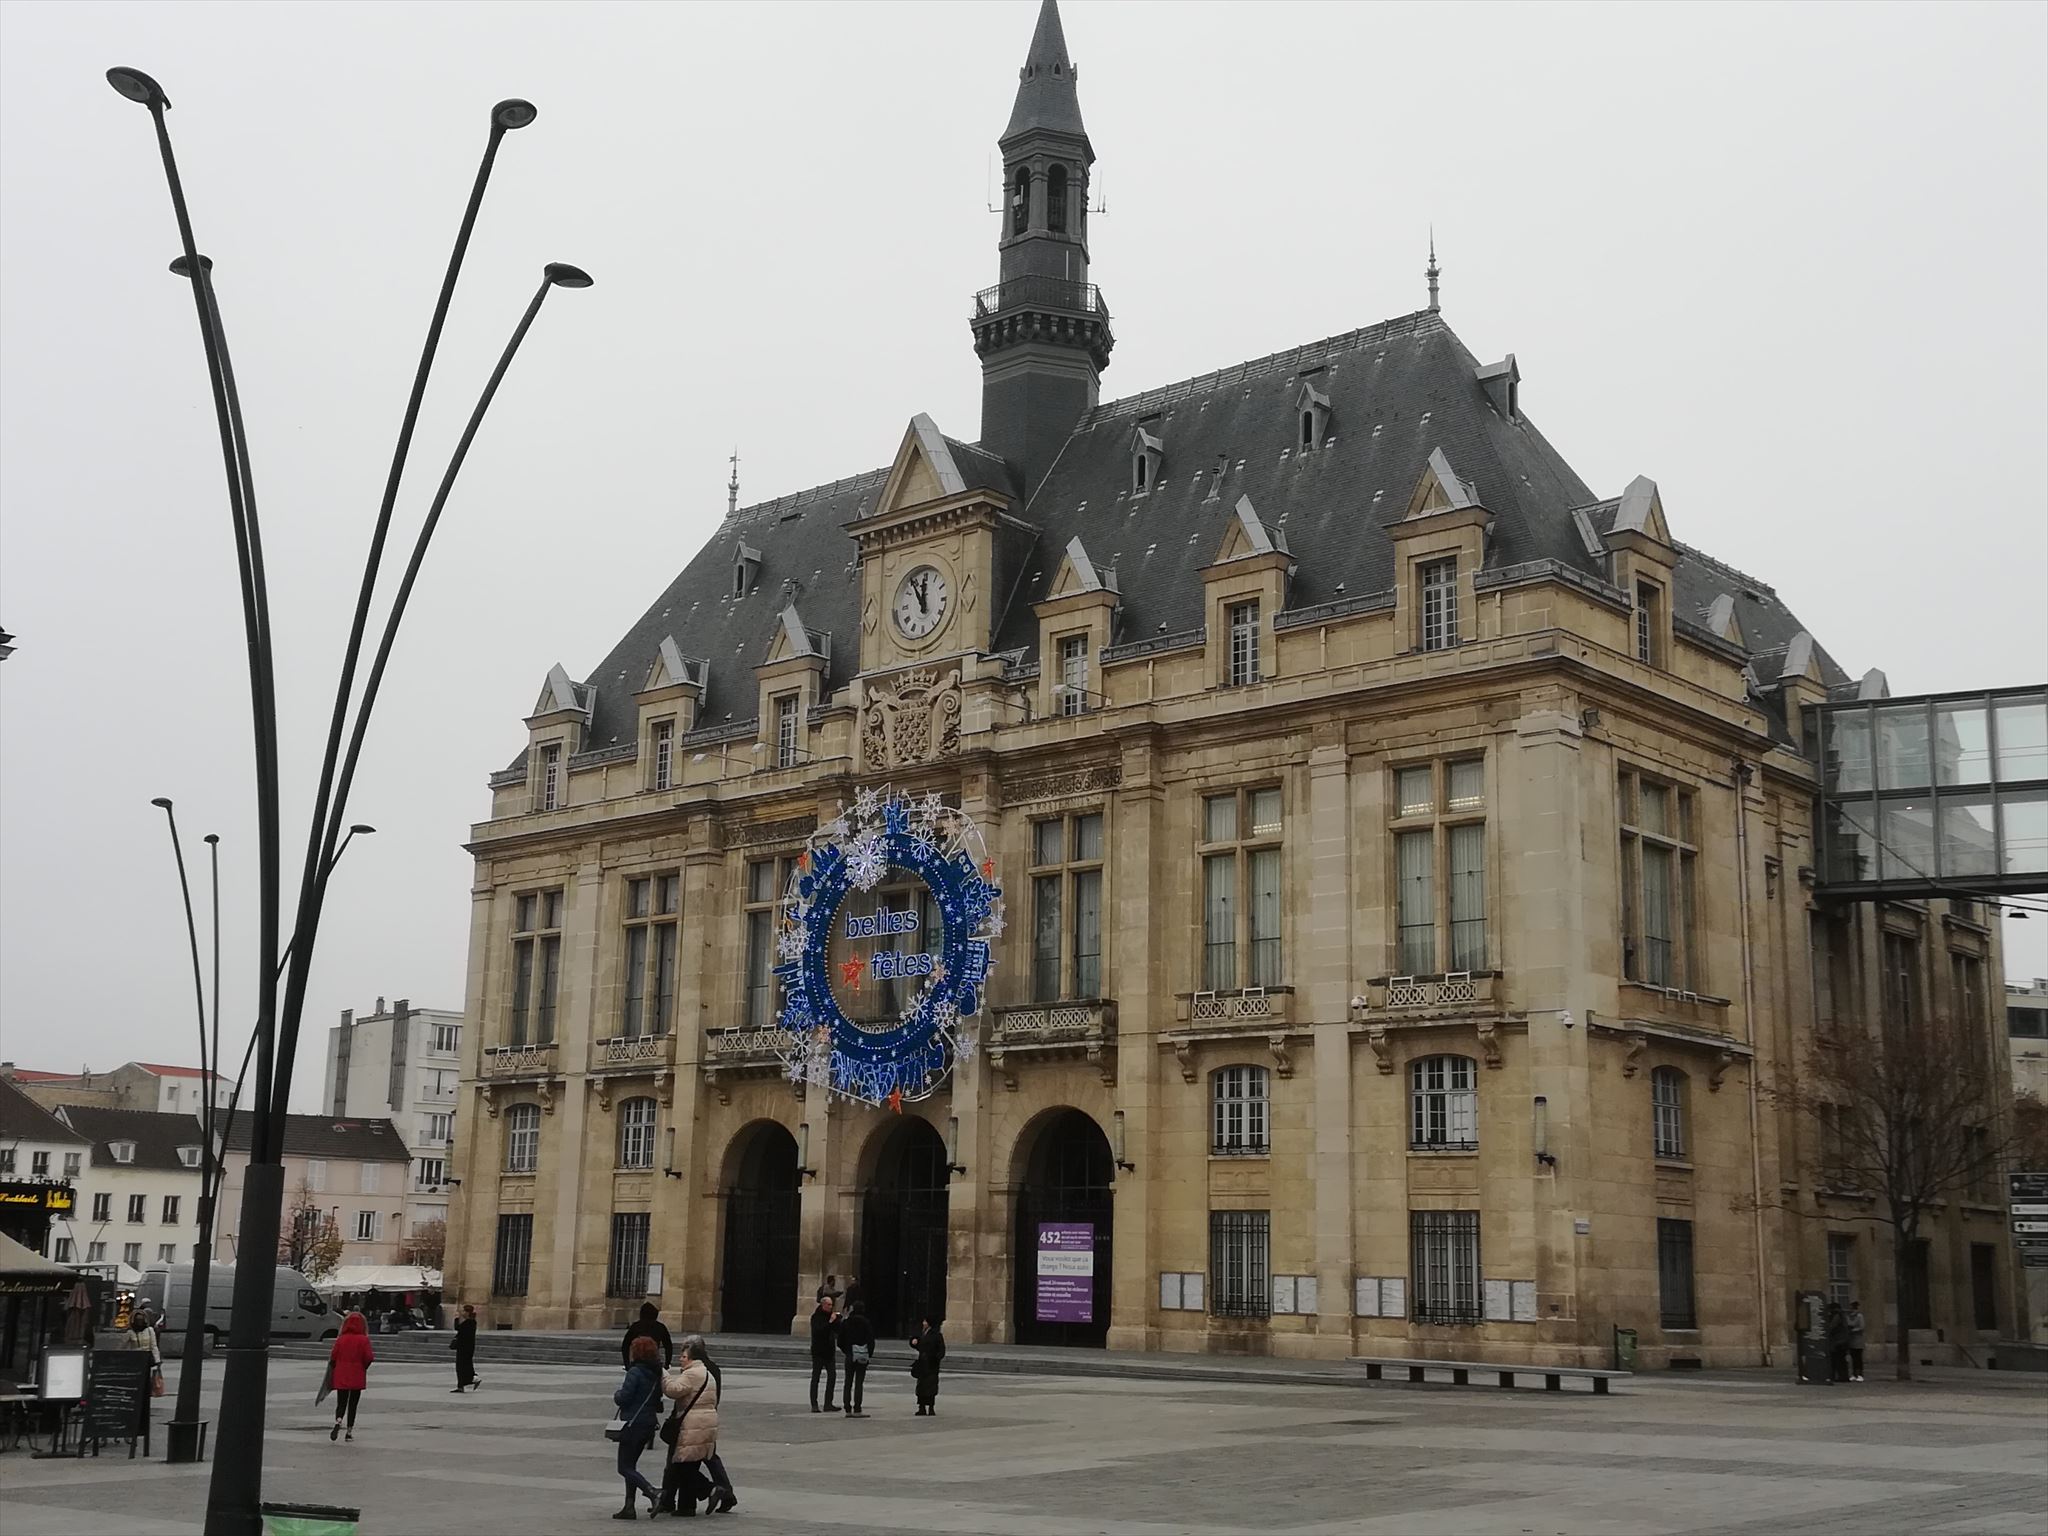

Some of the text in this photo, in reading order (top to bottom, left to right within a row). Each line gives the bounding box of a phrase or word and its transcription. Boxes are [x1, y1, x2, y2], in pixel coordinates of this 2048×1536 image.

[845, 909, 920, 939] belles
[871, 951, 932, 980] fêtes
[1040, 1231, 1061, 1244] 452
